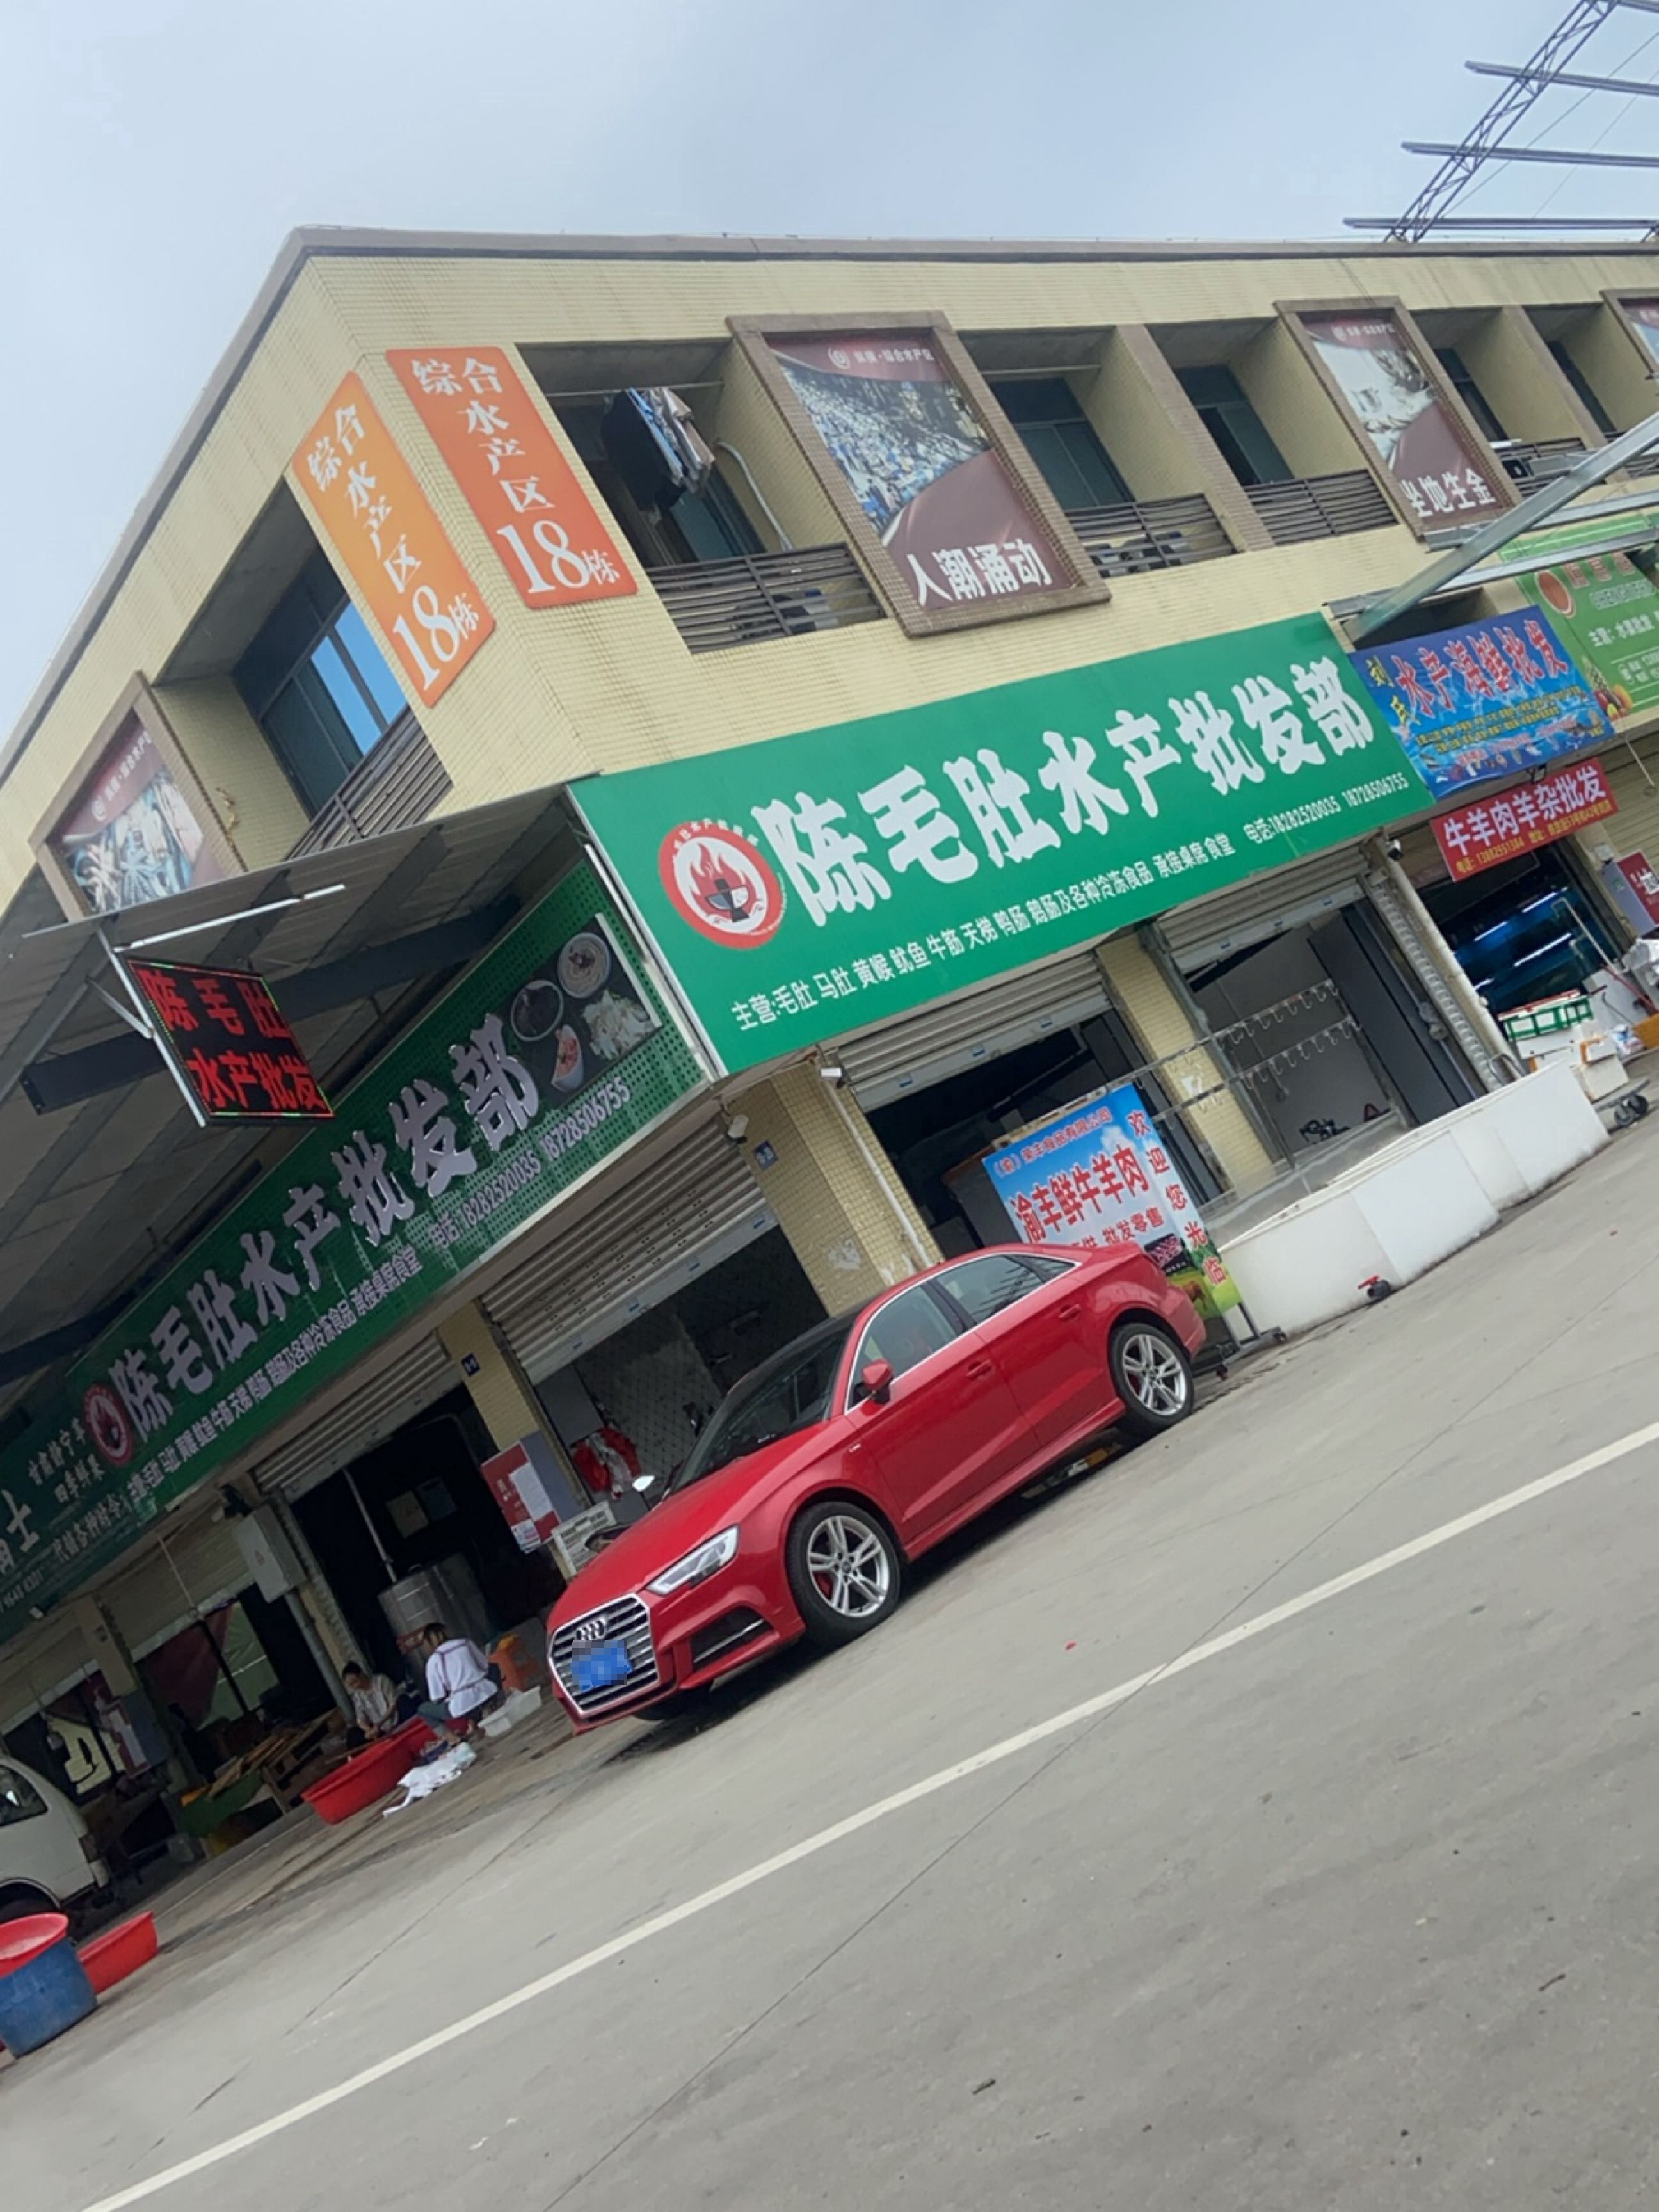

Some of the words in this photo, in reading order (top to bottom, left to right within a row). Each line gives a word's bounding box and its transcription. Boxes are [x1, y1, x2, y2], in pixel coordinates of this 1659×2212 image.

[411, 356, 502, 396] 综合
[307, 404, 365, 491] 综合
[457, 399, 556, 514] 水产区
[344, 461, 422, 594] 水产区
[496, 519, 621, 595] 18栋
[906, 538, 1053, 607] 人潮涌动
[392, 584, 480, 692] 18栋
[750, 656, 1374, 927] 陈毛肚水产批发部
[1444, 765, 1605, 856] 牛羊肉羊杂批发
[137, 968, 293, 1038] 陈毛肚
[187, 1047, 327, 1110] 水产批发
[540, 1077, 630, 1162] 18728506755
[109, 1013, 539, 1443] 陈毛肚水产批发部
